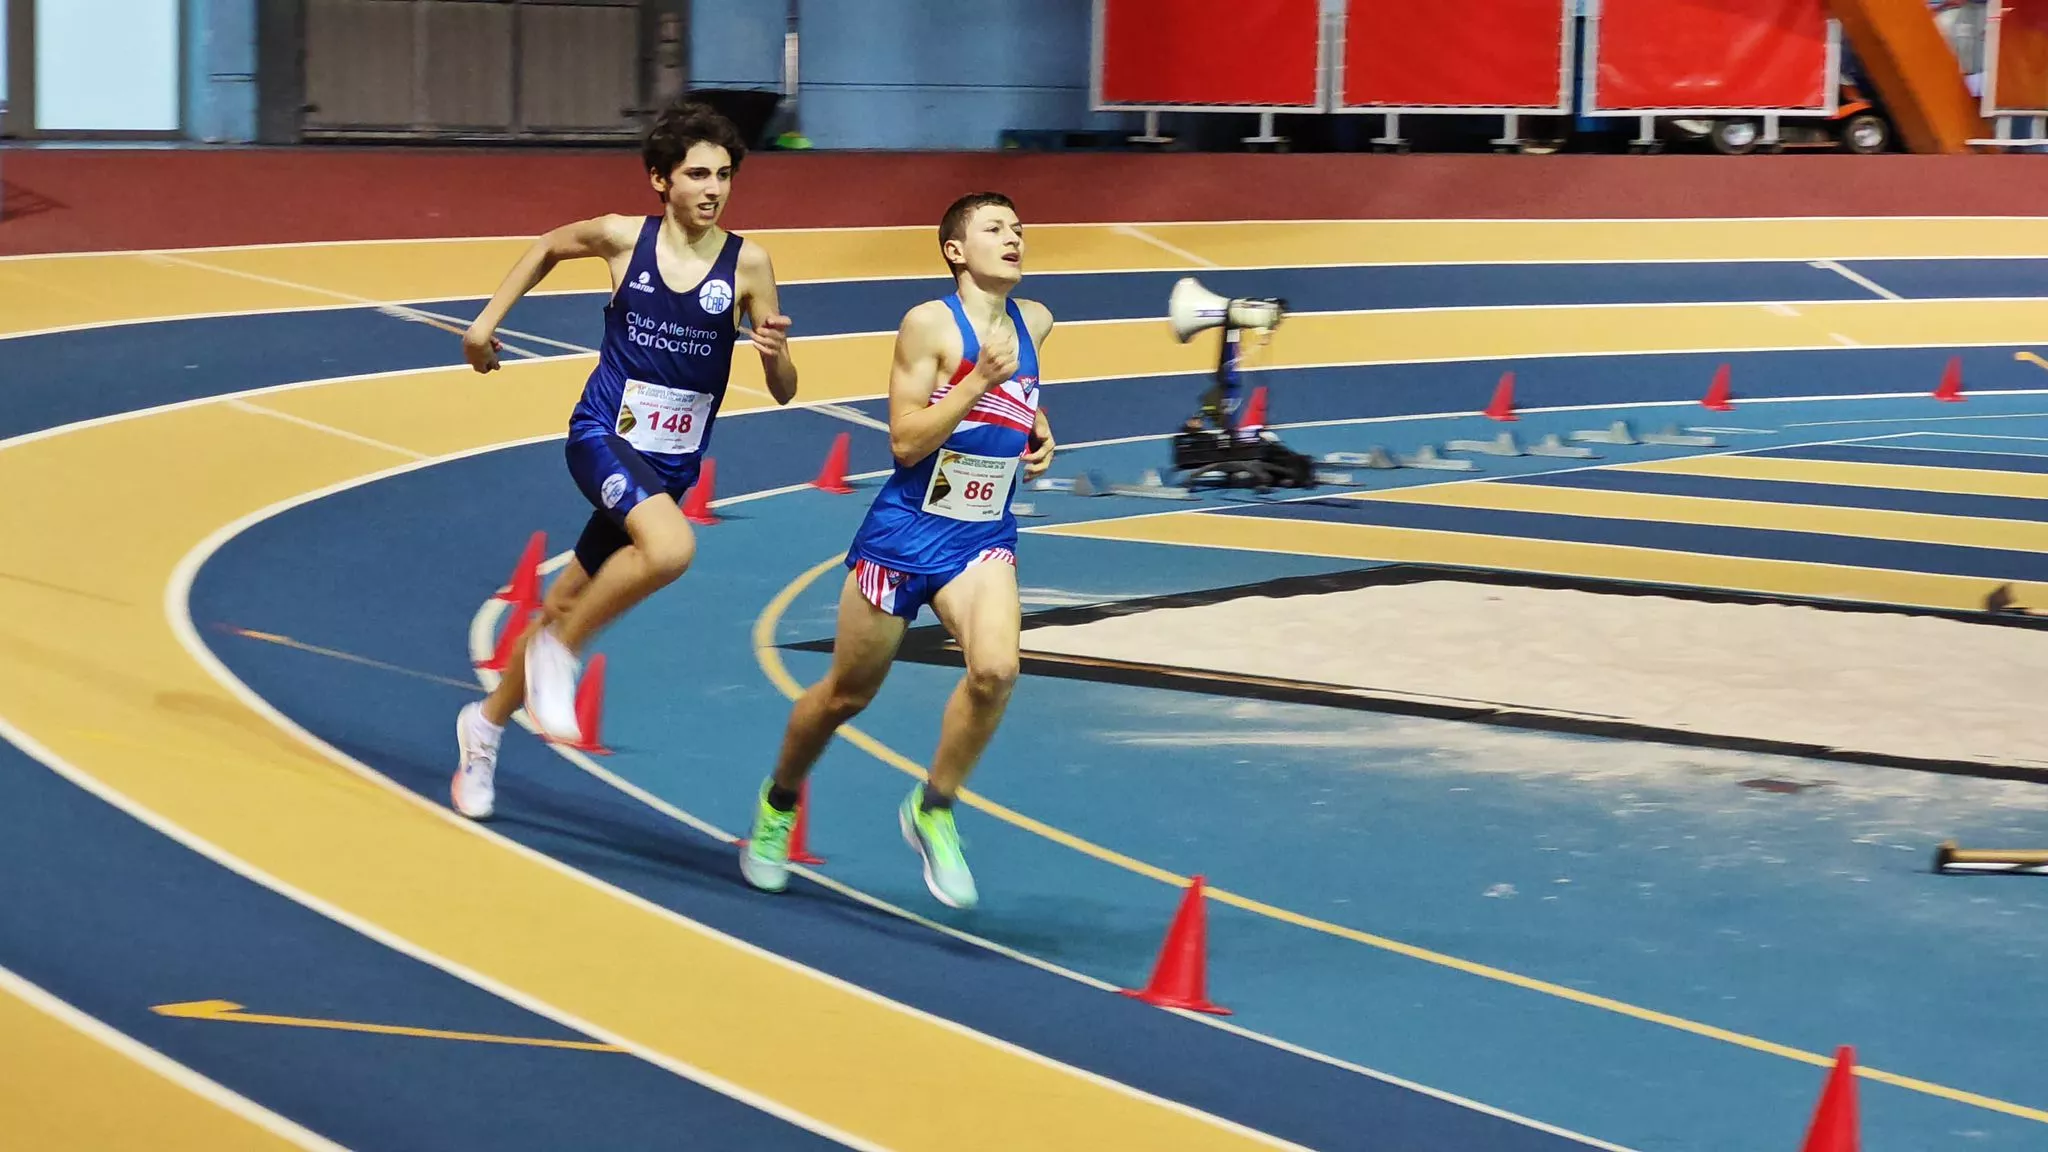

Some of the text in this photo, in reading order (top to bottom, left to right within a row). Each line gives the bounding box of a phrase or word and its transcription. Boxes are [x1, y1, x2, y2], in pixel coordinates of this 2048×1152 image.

[626, 311, 718, 340] Club Atletismo
[628, 326, 712, 357] Barbastro
[647, 410, 693, 434] 148
[964, 480, 995, 501] 86
